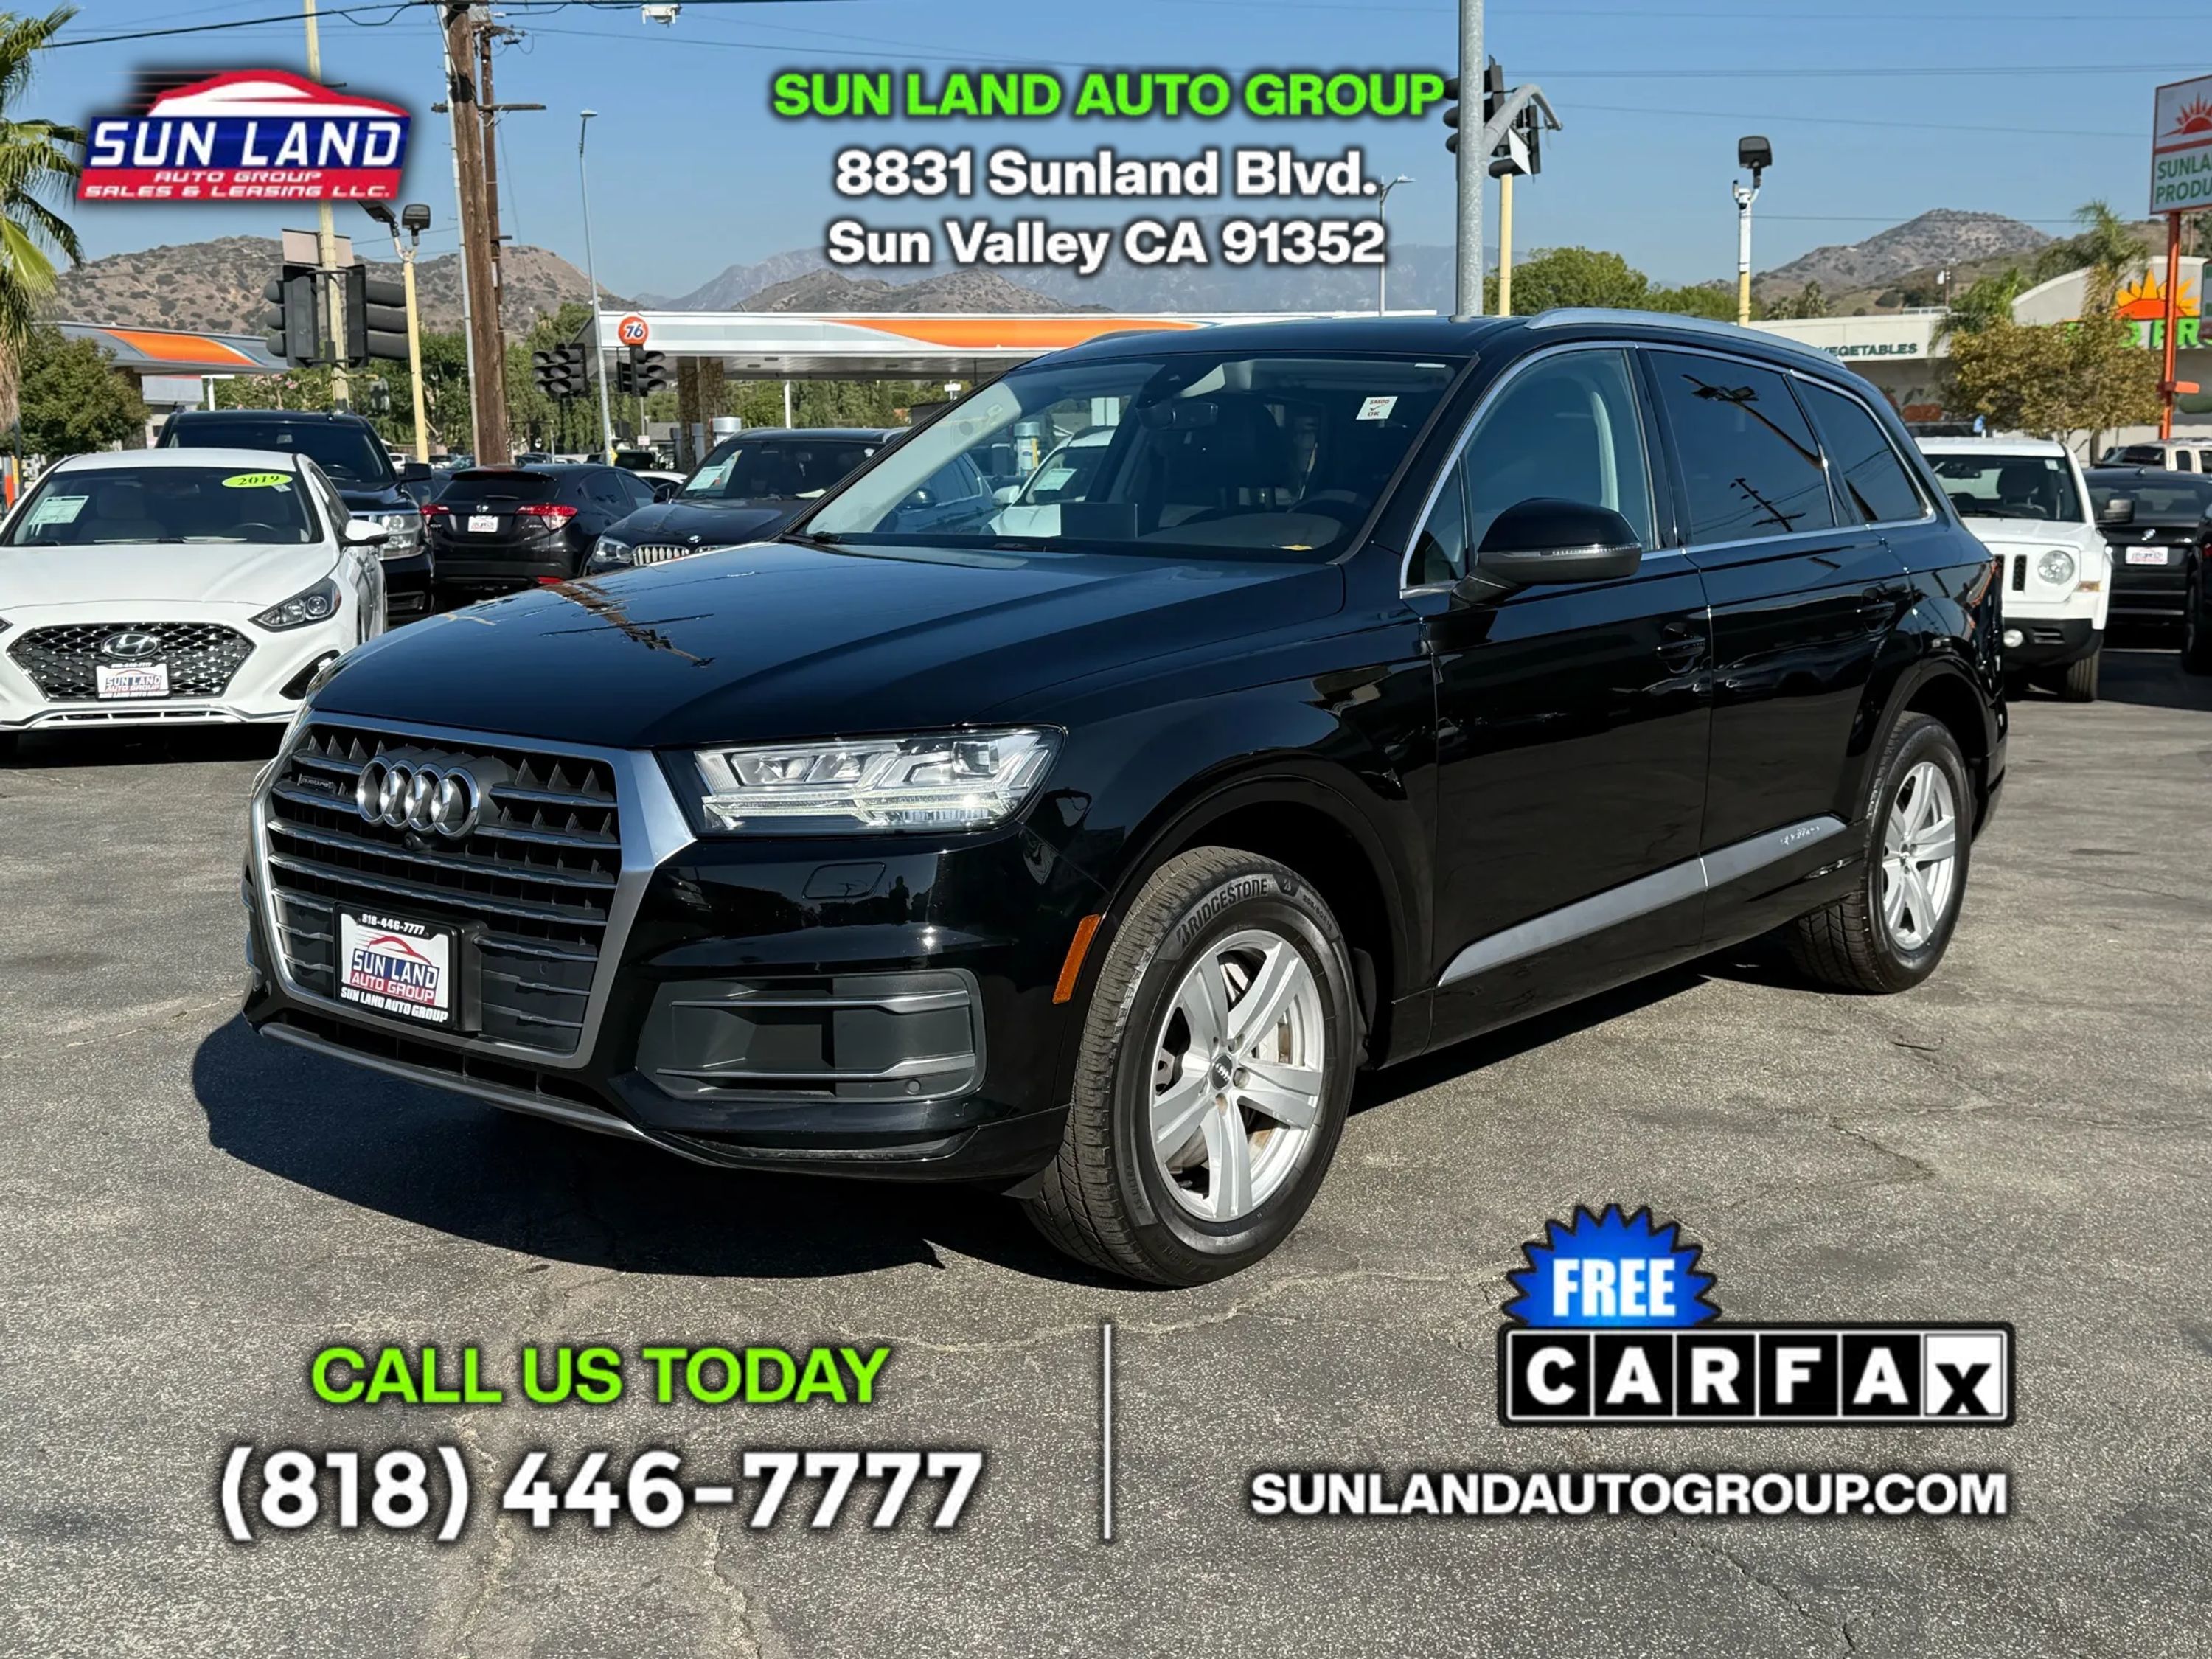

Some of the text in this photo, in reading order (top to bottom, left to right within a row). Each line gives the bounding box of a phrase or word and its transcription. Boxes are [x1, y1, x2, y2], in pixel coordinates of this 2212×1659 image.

[626, 324, 644, 338] 76
[238, 475, 279, 486] 2019
[106, 675, 161, 686] SUN LAND
[362, 914, 425, 936] 818-446-7777
[1176, 878, 1269, 948] BRIDGESTONE
[353, 950, 438, 989] SUN LAND
[352, 973, 434, 1003] AUTO GROUP
[341, 986, 448, 1023] SUN LAND AUTO GROUP
